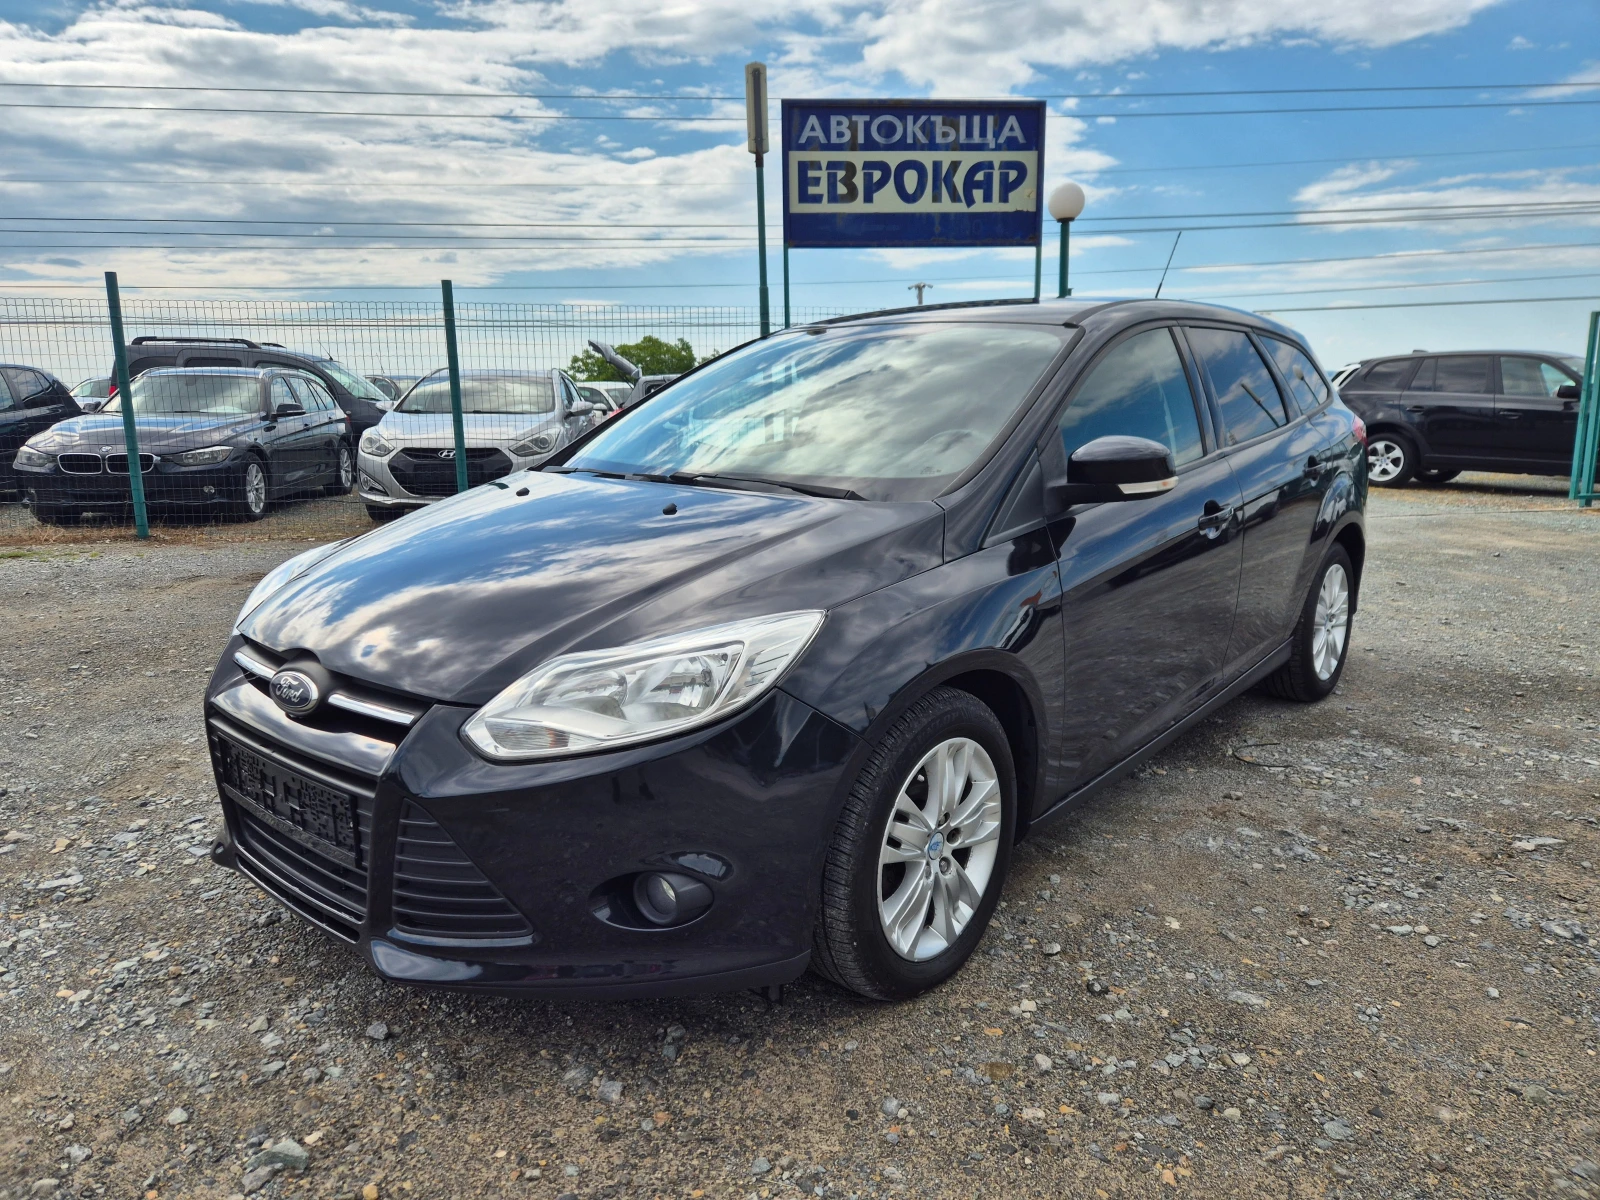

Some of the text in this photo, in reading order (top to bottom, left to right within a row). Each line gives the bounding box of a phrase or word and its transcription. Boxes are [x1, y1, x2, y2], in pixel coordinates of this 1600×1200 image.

[798, 114, 1026, 148] АВТОКЪЩА
[797, 159, 1028, 209] ЕВРОКАР
[275, 676, 304, 703] Ford
